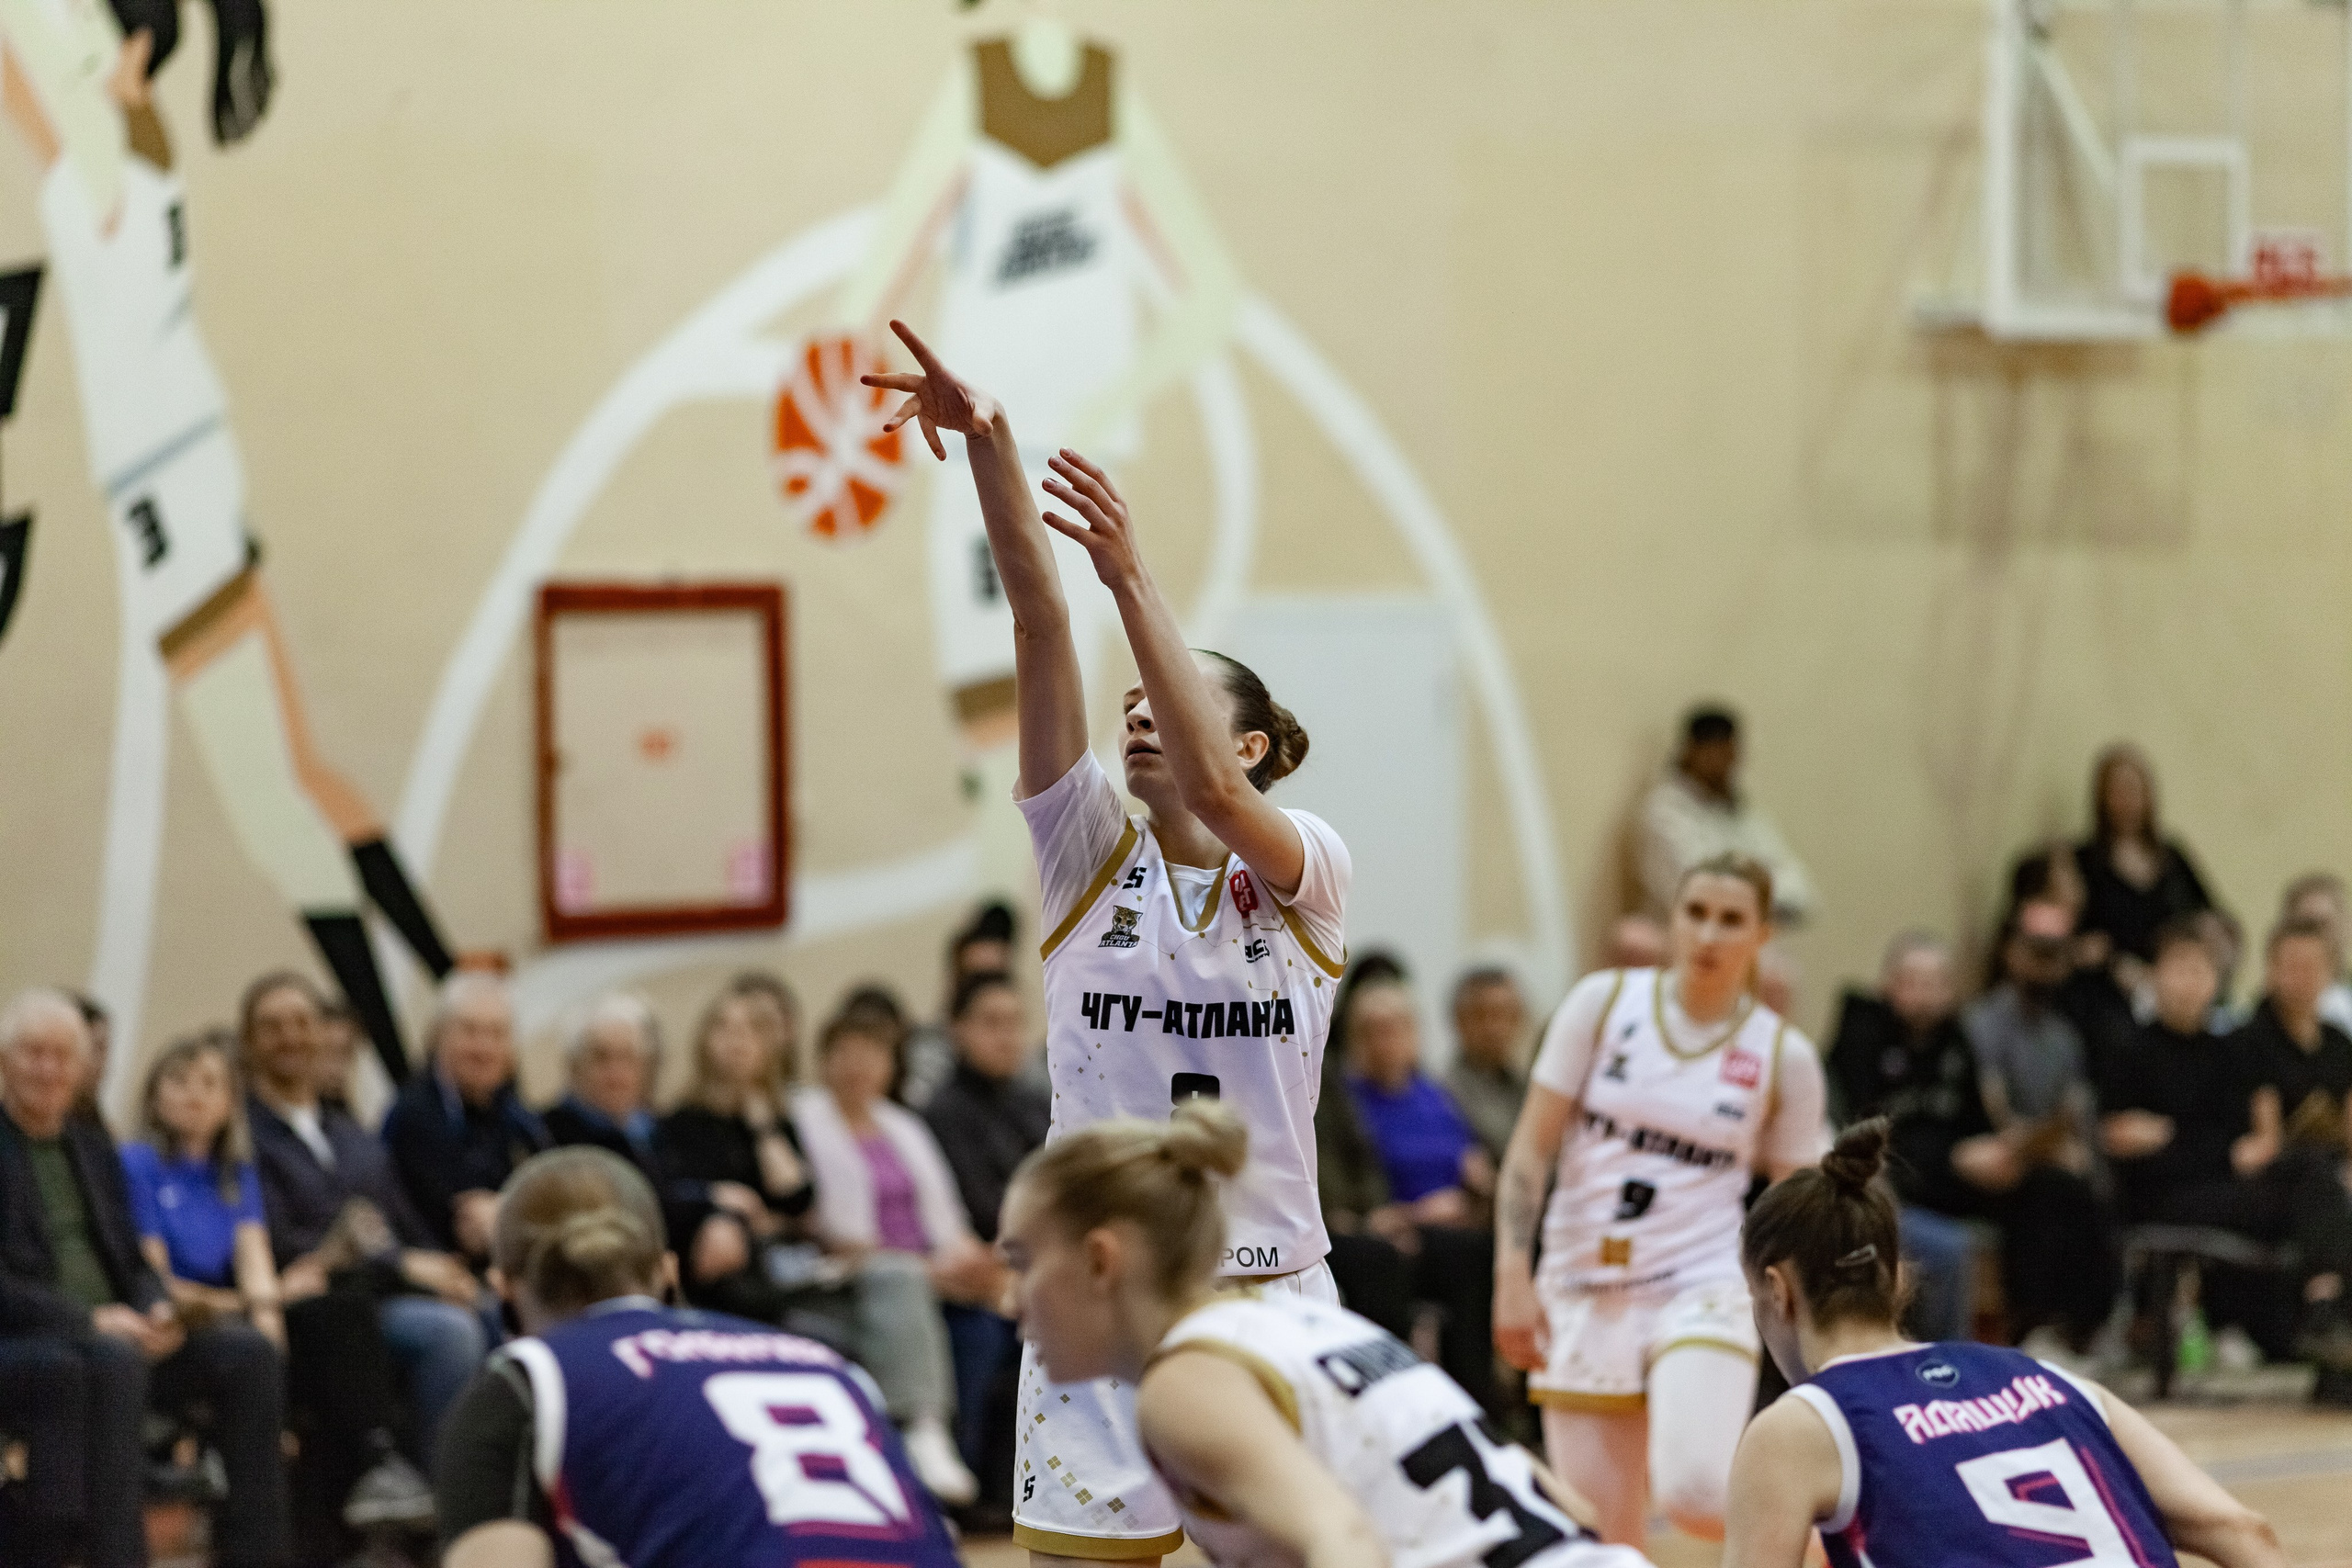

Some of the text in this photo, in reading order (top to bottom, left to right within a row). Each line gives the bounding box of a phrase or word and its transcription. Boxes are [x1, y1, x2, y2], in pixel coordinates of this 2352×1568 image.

[1100, 940, 1139, 948] ATLANTA
[1081, 992, 1295, 1039] ЧГУ-АТЛАНА
[1614, 1179, 1657, 1223] 9
[704, 1371, 911, 1528] 8
[1954, 1437, 2141, 1568] 9
